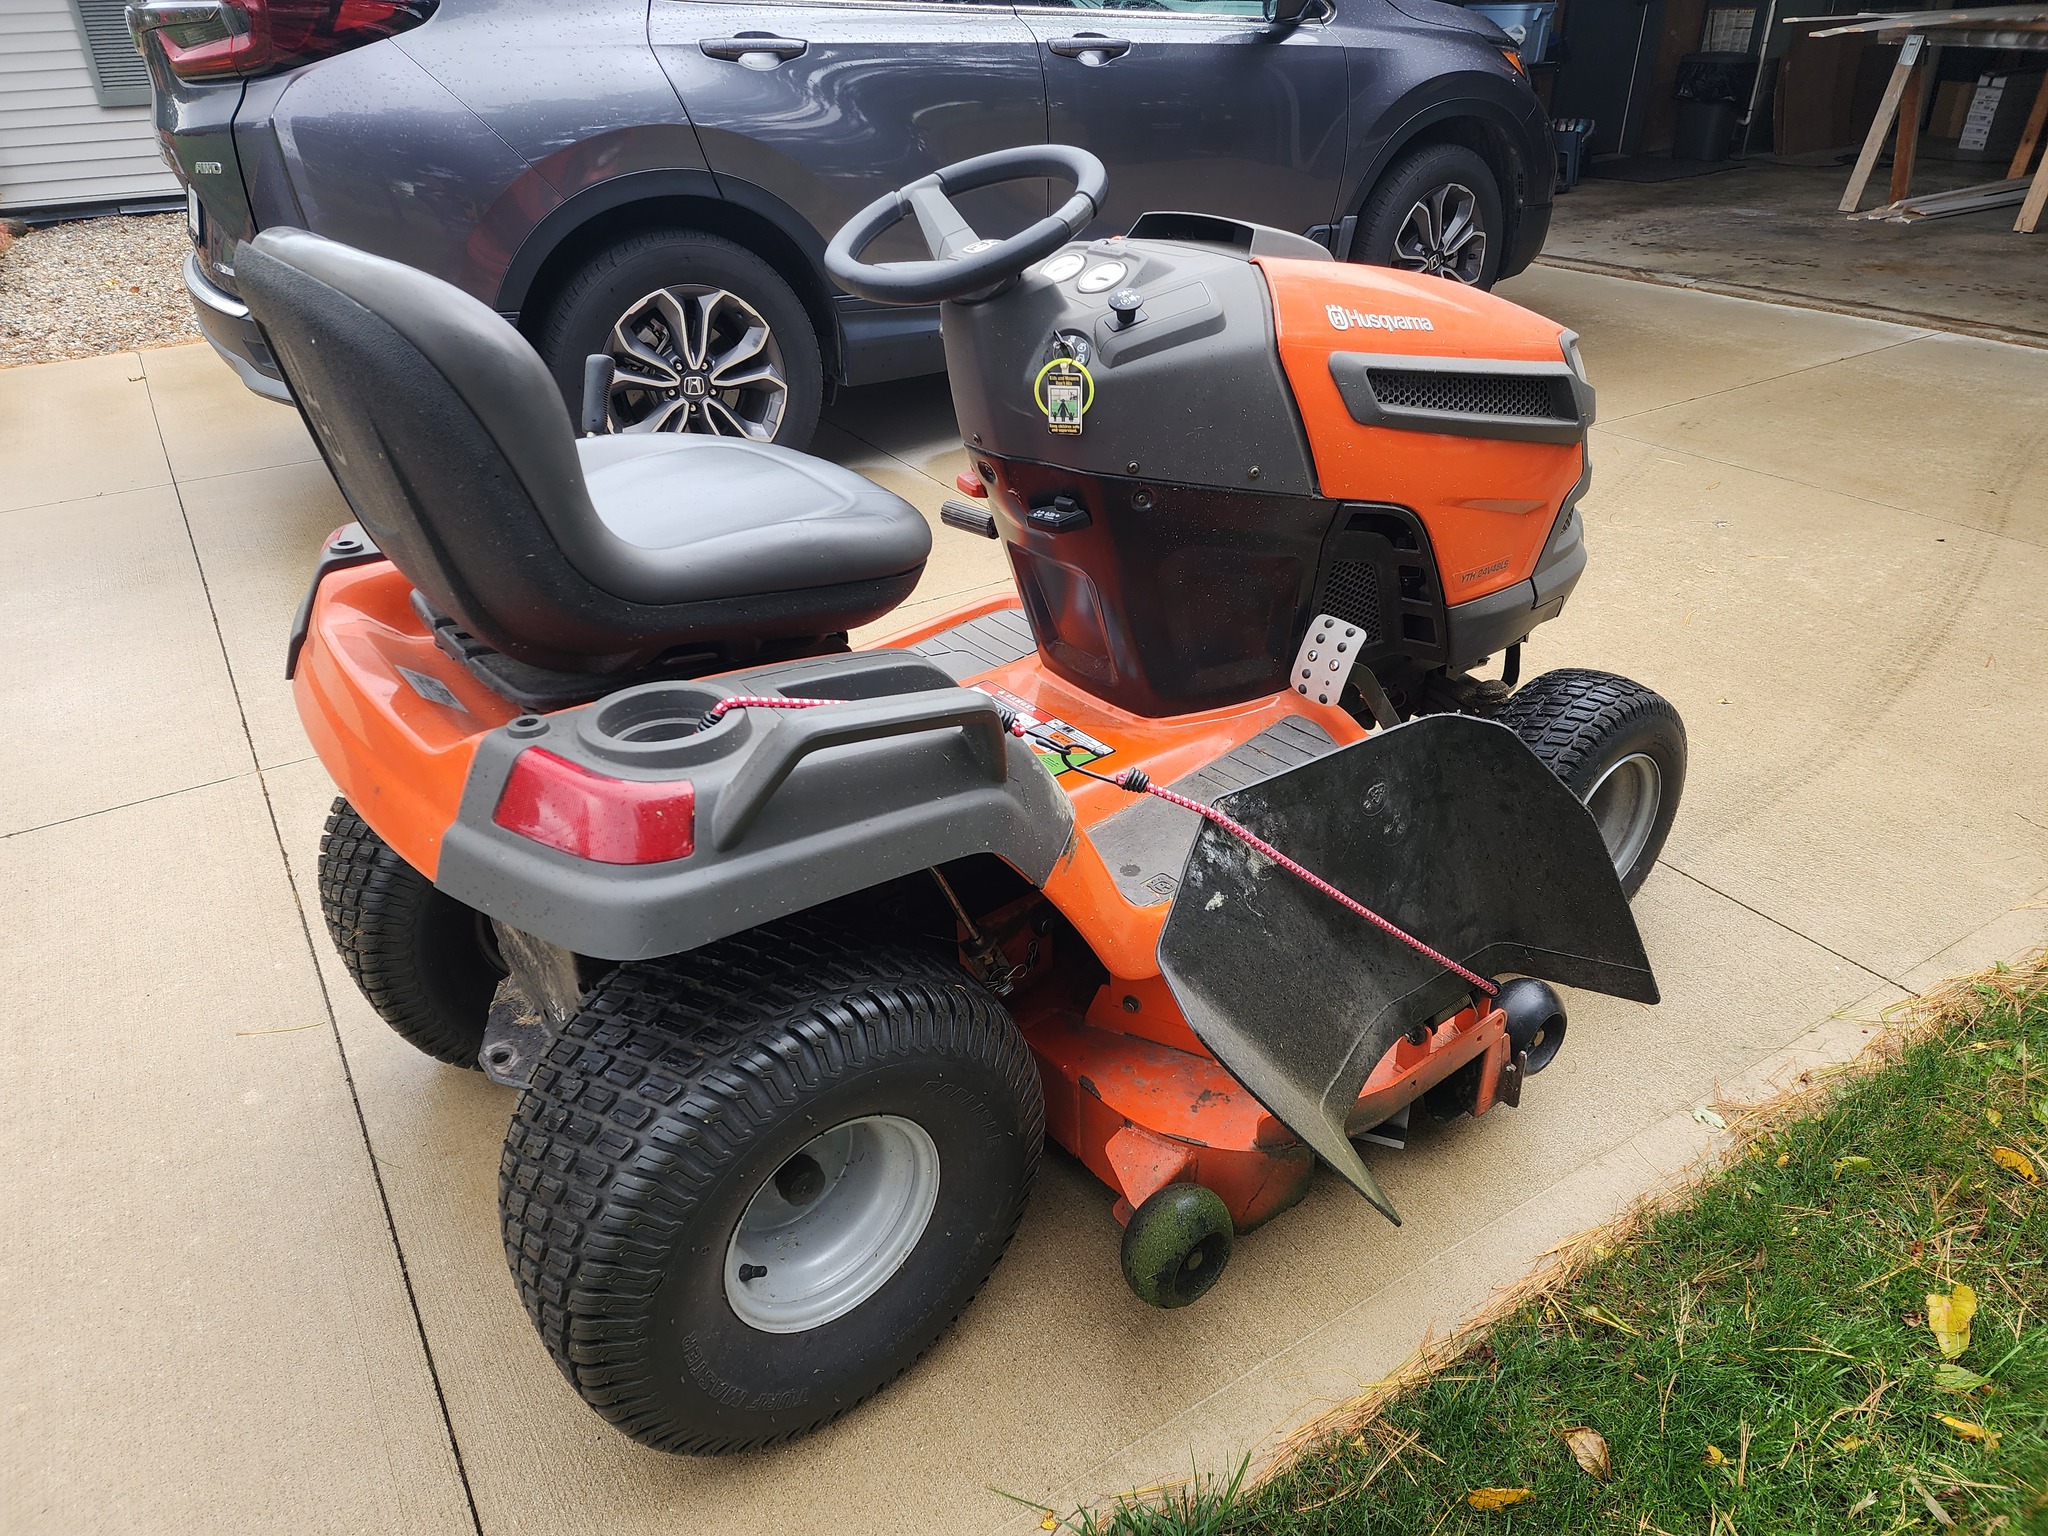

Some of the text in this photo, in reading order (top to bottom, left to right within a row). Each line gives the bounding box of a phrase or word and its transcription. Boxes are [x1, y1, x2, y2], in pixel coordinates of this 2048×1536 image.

[195, 161, 222, 175] AWD
[1345, 309, 1434, 332] Husqvarna
[1461, 571, 1477, 584] YTH
[681, 1330, 809, 1411] TURF MASTER
